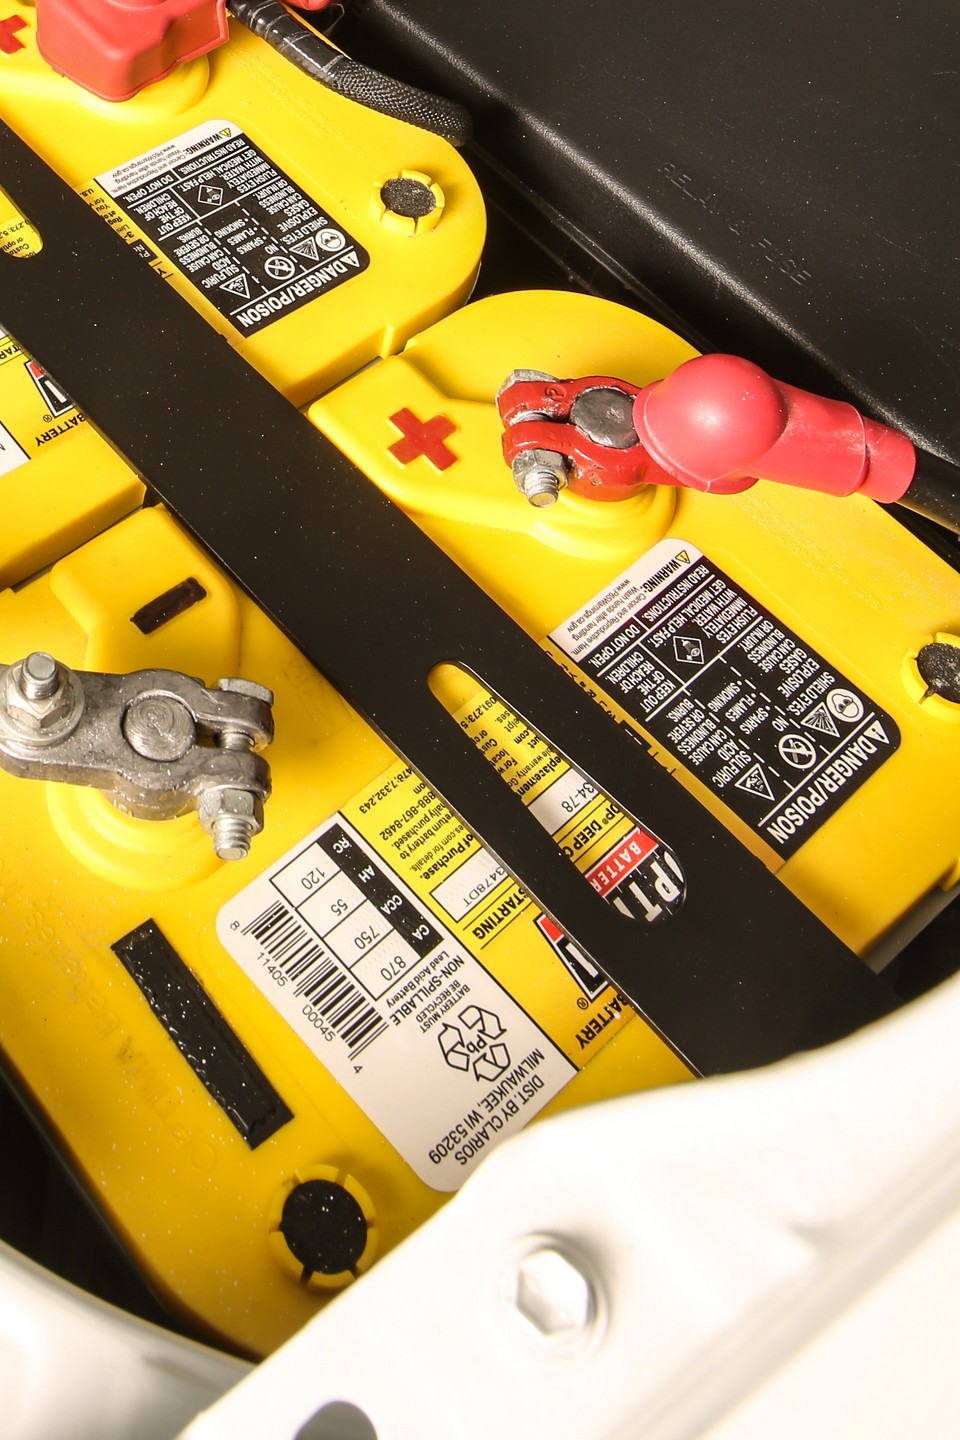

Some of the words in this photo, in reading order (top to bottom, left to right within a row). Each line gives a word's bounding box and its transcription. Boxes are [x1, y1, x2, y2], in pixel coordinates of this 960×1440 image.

[181, 132, 223, 155] WARNING:
[225, 160, 271, 189] IMMEDIATELY
[132, 191, 172, 215] CHILDREN.
[257, 184, 296, 208] BLINDNESS
[282, 198, 310, 217] GASES
[212, 217, 246, 239] SMOKING
[275, 205, 319, 233] EXPLOSIVE
[299, 215, 328, 235] SHIELD
[175, 225, 204, 244] BURNS.
[225, 226, 256, 246] FLAMES
[235, 235, 264, 255] SPARKS
[278, 228, 305, 245] EYES.
[177, 240, 218, 266] BLINDNESS
[263, 242, 280, 255] NO
[210, 254, 232, 271] ACID
[200, 262, 240, 289] SULFURIC
[235, 258, 349, 328] DANGER/POISON
[638, 558, 682, 593] WARNING:
[686, 563, 710, 584] READ
[620, 585, 640, 601] Wash
[707, 578, 727, 596] GET
[713, 587, 738, 609] WITH
[604, 597, 626, 614] hands
[625, 591, 647, 610] Cancer
[640, 577, 694, 622] INSTRUCTIONS.
[680, 588, 715, 618] MEDICAL
[593, 609, 608, 624] after
[615, 606, 629, 620] and
[665, 611, 688, 634] HELP
[690, 601, 721, 627] WATER.
[700, 595, 748, 639] IMMEDIATELY
[730, 604, 759, 630] FLUSH
[570, 619, 598, 642] handling.
[585, 614, 621, 644] Reproductive
[623, 622, 641, 639] DO
[646, 626, 672, 648] FAST.
[714, 622, 739, 644] EYES
[757, 618, 774, 633] OR
[569, 640, 590, 656] Harm.
[609, 631, 631, 652] NOT
[735, 626, 767, 653] INJURY.
[746, 627, 786, 664] BLINDNESS
[775, 637, 796, 656] CAN
[587, 645, 615, 669] OPEN.
[603, 650, 644, 685] CHILDREN.
[756, 648, 784, 673] CAUSE
[777, 646, 808, 674] GASES
[625, 659, 655, 686] REACH
[650, 669, 665, 685] OF
[776, 656, 821, 698] EXPLOSIVE
[618, 678, 634, 694] OF
[635, 677, 657, 696] THE
[653, 678, 677, 701] KEEP
[706, 681, 741, 713] SMOKING
[804, 670, 836, 700] SHIELD
[638, 693, 659, 713] OUT
[664, 697, 695, 723] BURNS.
[688, 707, 705, 723] OR
[724, 693, 756, 722] FLAMES
[784, 691, 814, 716] EYES.
[665, 715, 697, 744] SEVERE
[738, 706, 769, 735] SPARKS
[770, 714, 790, 732] NO
[676, 717, 717, 756] BLINDNESS
[707, 728, 728, 748] CAN
[687, 740, 715, 766] CAUSE
[716, 737, 740, 761] ACID
[711, 749, 752, 788] SULFURIC
[357, 779, 399, 815] 7,332,243
[765, 734, 878, 845] DANGER/POISON
[390, 812, 431, 851] purchased.
[405, 827, 436, 854] battery
[571, 818, 603, 851] DEEP
[331, 835, 351, 854] RC
[408, 850, 434, 872] details.
[418, 840, 467, 880] Purchase.
[299, 866, 325, 890] 120
[356, 863, 375, 883] AH
[329, 897, 349, 917] 55
[379, 893, 403, 915] CCA
[352, 924, 380, 950] 750
[410, 923, 430, 941] CA
[379, 954, 407, 982] 870
[428, 949, 450, 971] Lead
[412, 964, 432, 986] Acid
[447, 978, 461, 992] BE
[255, 951, 289, 987] 11405
[300, 1003, 336, 1042] 00045
[384, 979, 417, 1009] Battery
[388, 953, 465, 1027] NON-SPILLABLE
[438, 983, 471, 1016] BATTERY
[414, 987, 452, 1023] RECYCLED
[418, 1010, 442, 1034] MUST
[462, 1032, 488, 1054] Pb
[475, 1047, 545, 1113] MILWAUKEE,
[512, 1073, 545, 1106] DIST.
[462, 1108, 484, 1130] WI
[499, 1097, 520, 1120] BY
[427, 1122, 469, 1165] 53209
[453, 1114, 504, 1166] CLARIOS
